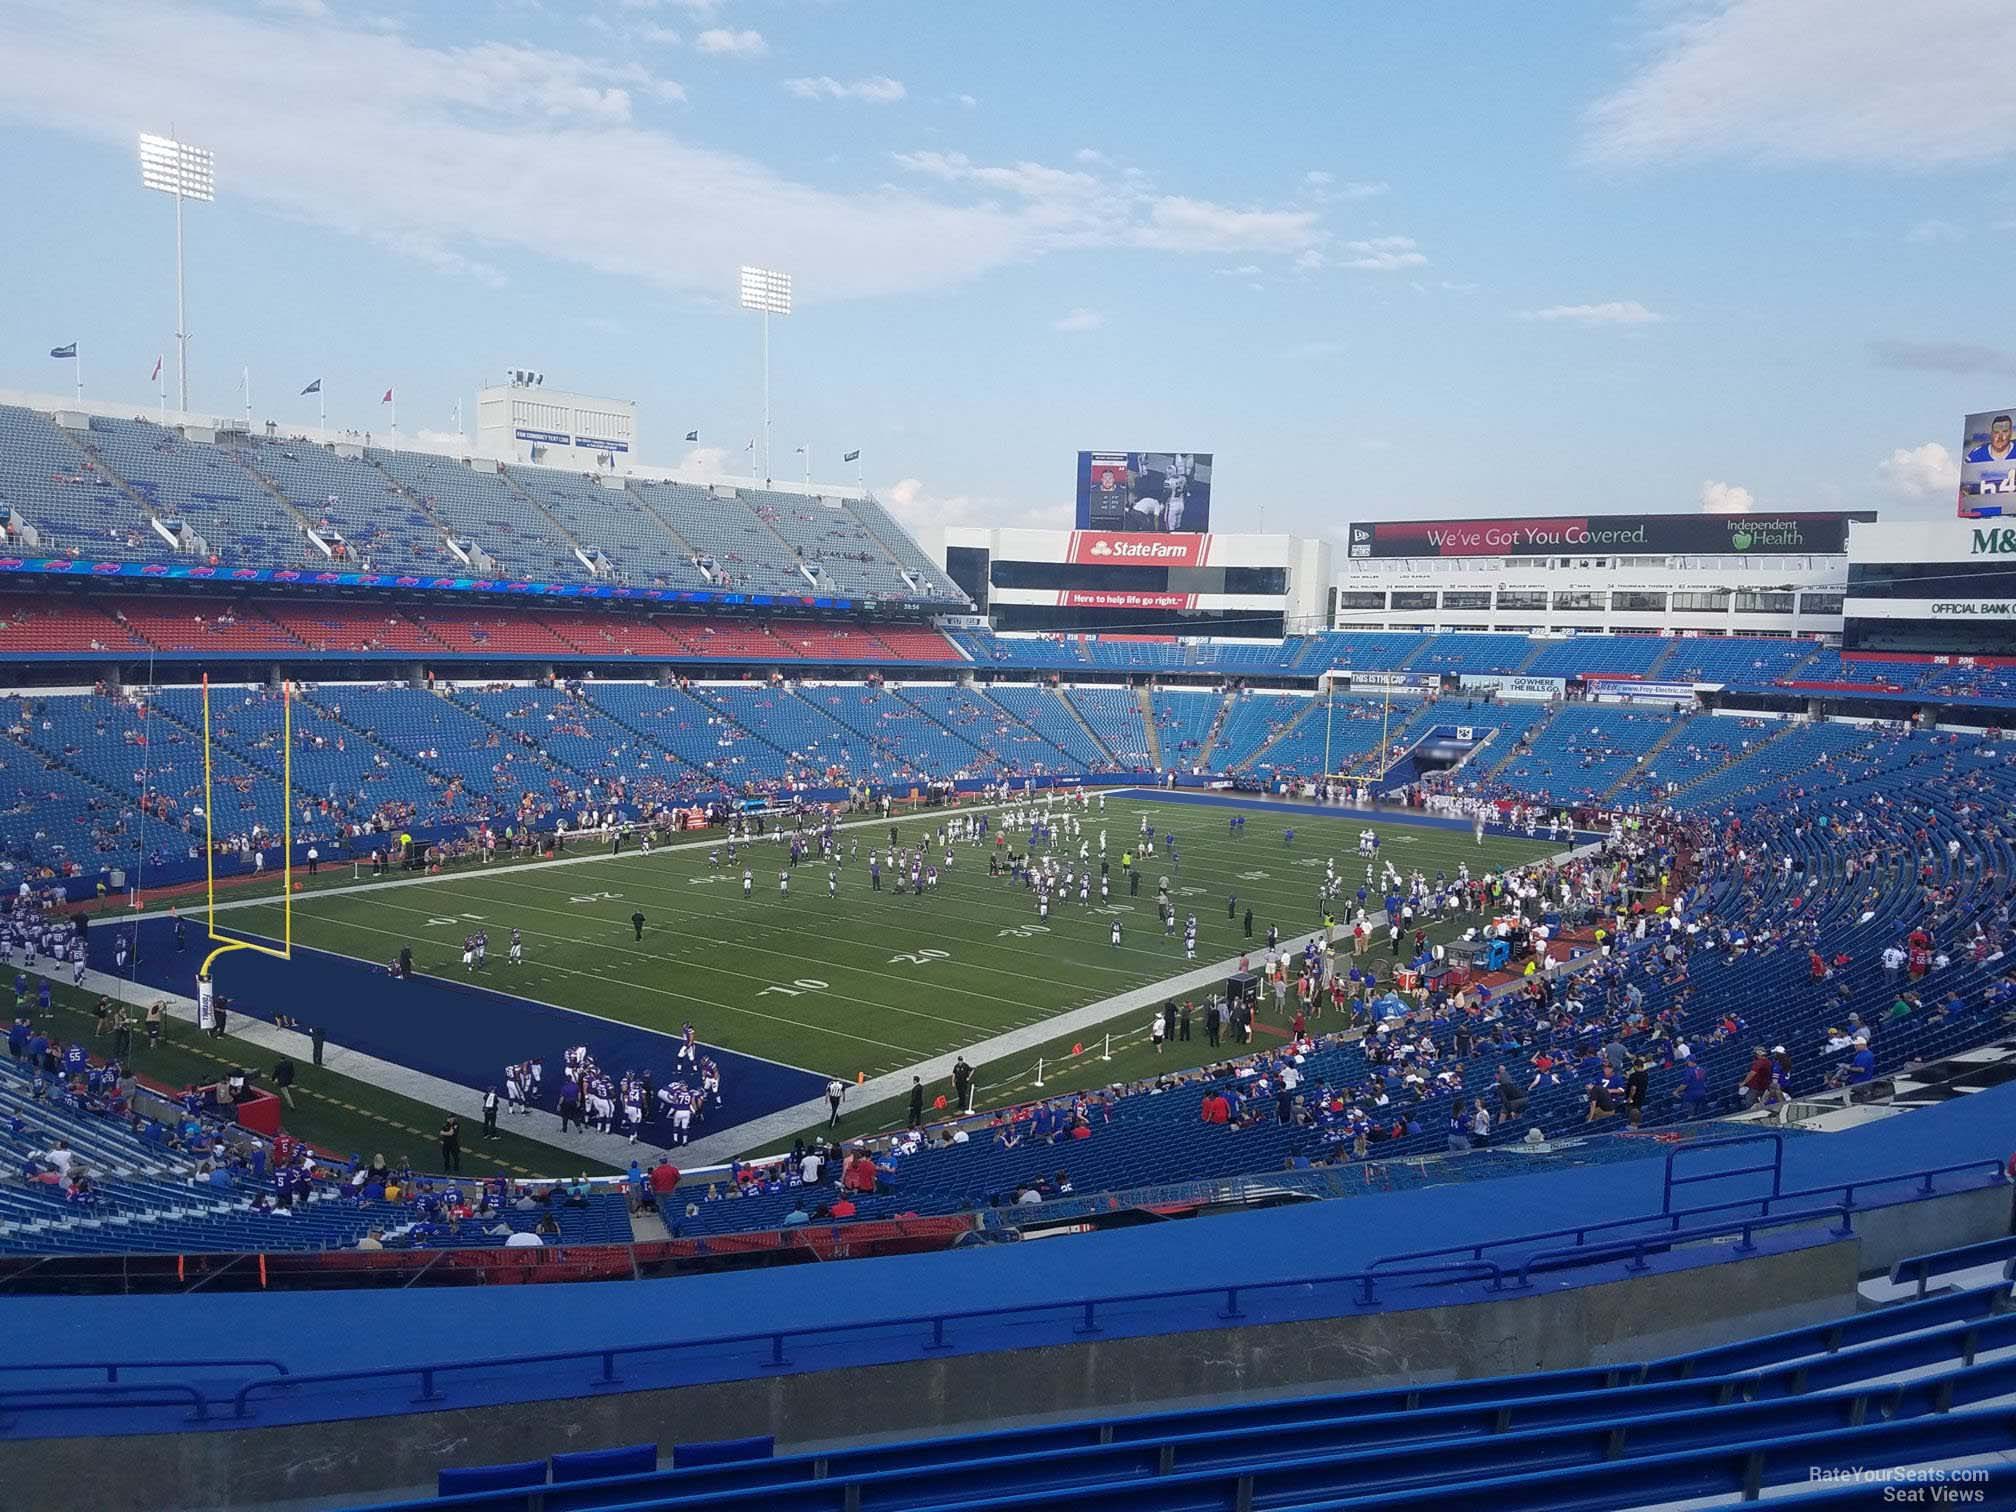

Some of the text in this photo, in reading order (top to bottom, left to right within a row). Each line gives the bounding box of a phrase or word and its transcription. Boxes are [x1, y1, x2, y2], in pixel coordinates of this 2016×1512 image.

[1727, 519, 1797, 532] Independent
[1427, 524, 1648, 546] We've Got You Covered.
[1753, 530, 1803, 545] Health
[1113, 541, 1187, 557] StateFarm
[1073, 594, 1095, 603] Here
[1096, 595, 1106, 603] to
[1107, 595, 1125, 606] help
[1126, 595, 1141, 604] life
[1142, 597, 1154, 606] go
[1931, 603, 1978, 614] OFFICIAL
[1981, 603, 2010, 614] BANK
[1934, 656, 1950, 664] 225
[1352, 673, 1369, 683] THIS
[1369, 674, 1377, 683] IS
[1391, 674, 1406, 685] CAP
[1527, 678, 1555, 686] WHERE
[1526, 684, 1546, 692] BILLS
[1002, 924, 1051, 937] 30
[893, 948, 951, 965] 20
[765, 978, 830, 997] 10
[69, 1052, 81, 1063] 55
[1602, 1078, 1610, 1088] 7
[678, 1095, 691, 1105] 79
[282, 1143, 289, 1153] 5
[277, 1176, 284, 1187] 5
